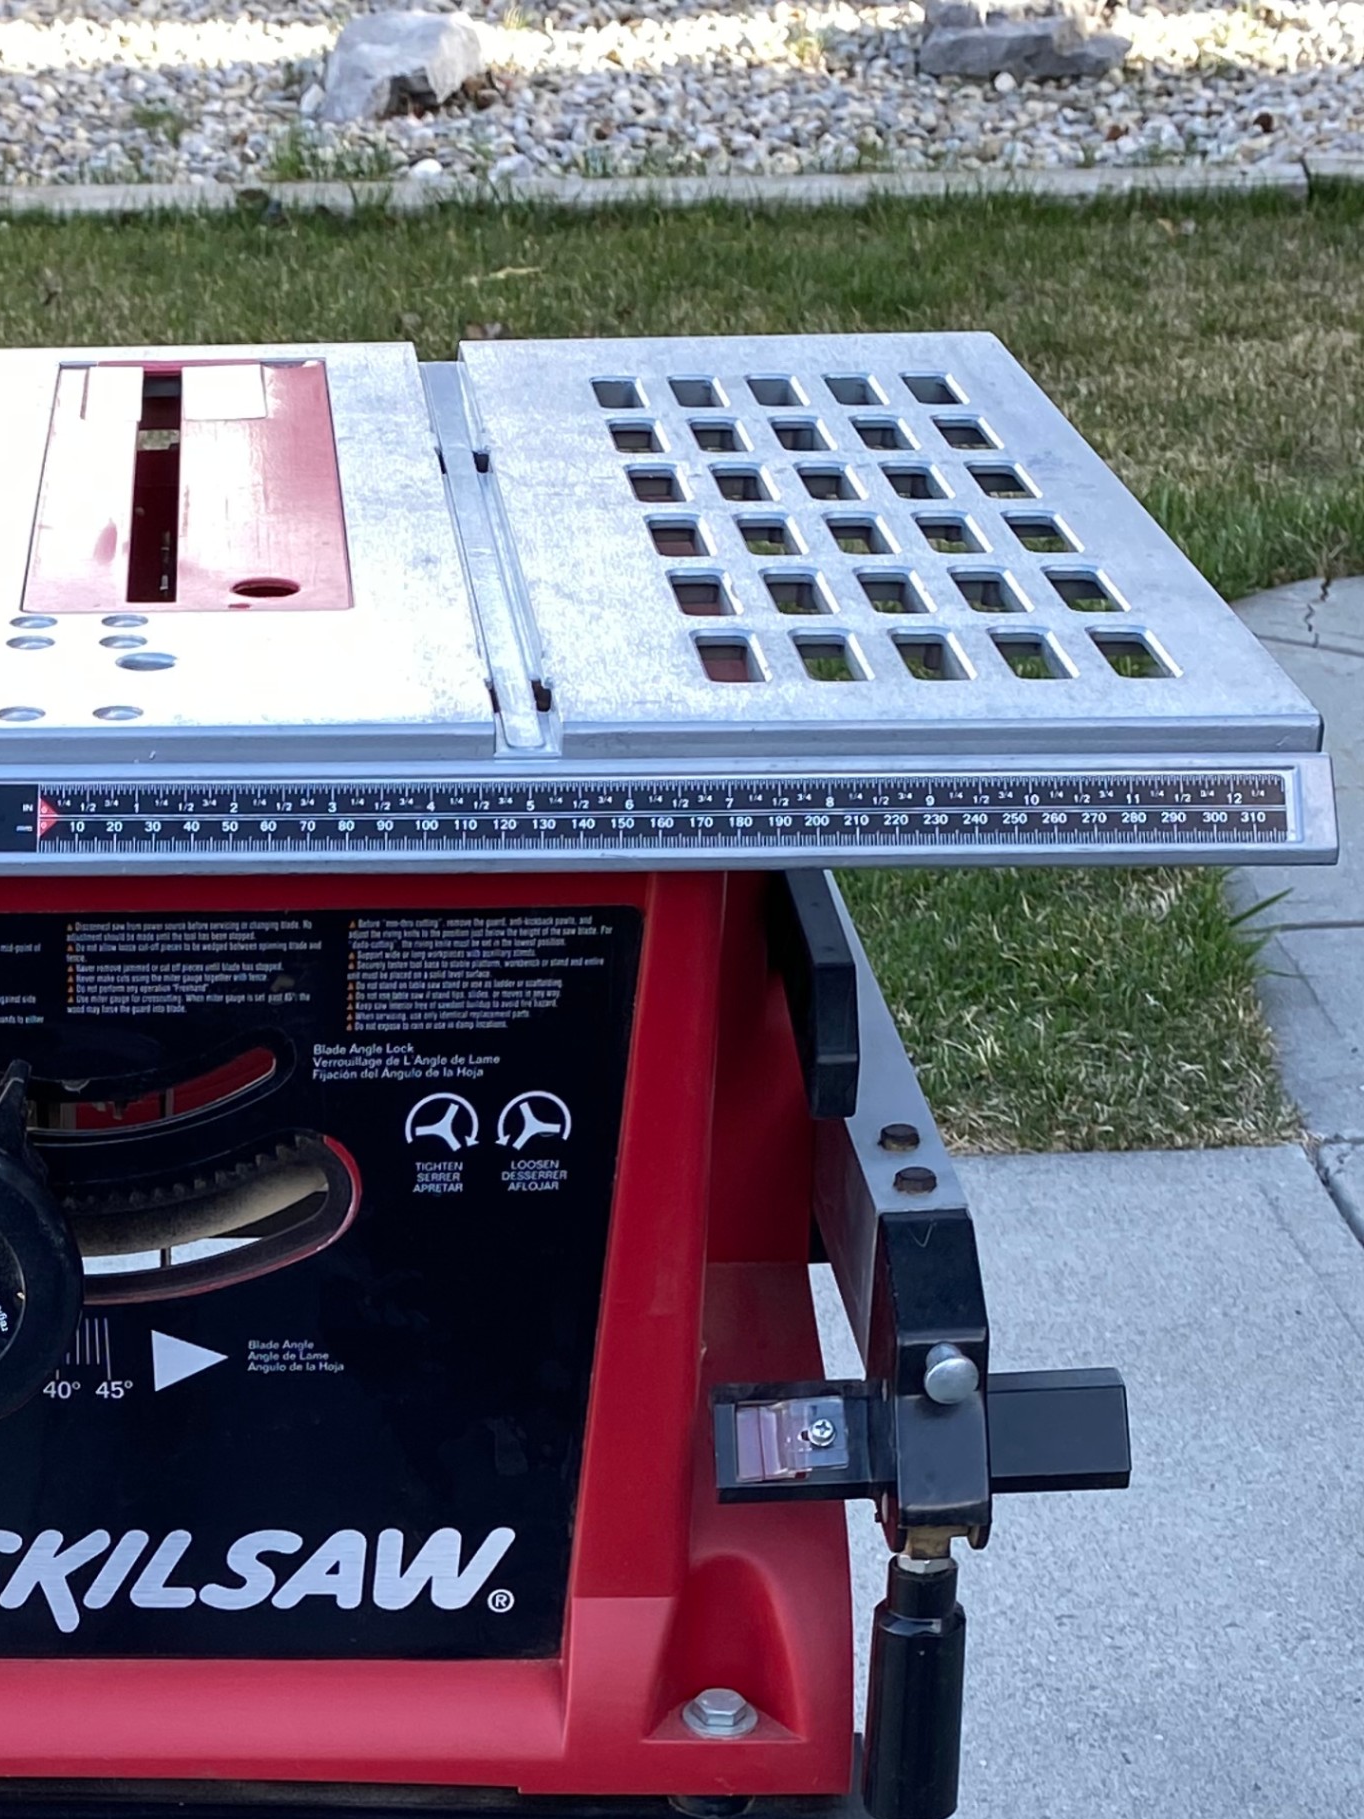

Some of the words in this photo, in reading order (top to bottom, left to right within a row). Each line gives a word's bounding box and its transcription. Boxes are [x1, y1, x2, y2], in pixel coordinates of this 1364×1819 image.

[1024, 794, 1040, 806] 10
[1126, 794, 1140, 805] 11
[1226, 793, 1242, 804] 12
[70, 819, 84, 832] 10
[106, 820, 122, 832] 20
[144, 820, 162, 832] 30
[184, 820, 200, 832] 40
[222, 820, 238, 832] 50
[260, 820, 276, 832] 60
[300, 820, 316, 832] 70
[338, 819, 354, 832] 80
[376, 819, 394, 831] 90
[416, 819, 438, 831] 100
[454, 818, 478, 831] 110
[494, 818, 516, 830] 120
[532, 817, 556, 830] 130
[572, 817, 596, 829] 140
[610, 817, 634, 829] 150
[650, 816, 674, 829] 160
[690, 816, 714, 828] 170
[730, 816, 752, 828] 180
[768, 815, 792, 828] 190
[804, 815, 830, 827] 200
[844, 813, 870, 826] 210
[884, 813, 908, 825] 220
[924, 813, 948, 825] 230
[962, 813, 988, 825] 240
[1002, 813, 1028, 825] 250
[1042, 812, 1068, 825] 260
[1082, 812, 1108, 825] 270
[1122, 812, 1146, 824] 280
[1160, 812, 1186, 824] 290
[1202, 812, 1228, 824] 300
[1240, 812, 1266, 824] 310
[313, 1044, 346, 1055] Blade
[349, 1043, 382, 1056] Angle
[386, 1042, 414, 1054] Lock
[312, 1056, 382, 1068] Verrouillage
[386, 1056, 400, 1066] de
[450, 1055, 465, 1064] de
[468, 1054, 501, 1064] Lame
[456, 1066, 484, 1080] Hoja
[414, 1162, 464, 1172] TIGHTEN
[510, 1160, 560, 1170] LOOSEN
[412, 1182, 464, 1193] APRETAR
[507, 1181, 560, 1192] AFLOJAR
[248, 1340, 280, 1350] Blade
[282, 1340, 314, 1352] Angle
[282, 1351, 296, 1360] de
[299, 1351, 329, 1360] Lame
[319, 1362, 344, 1373] Hoja
